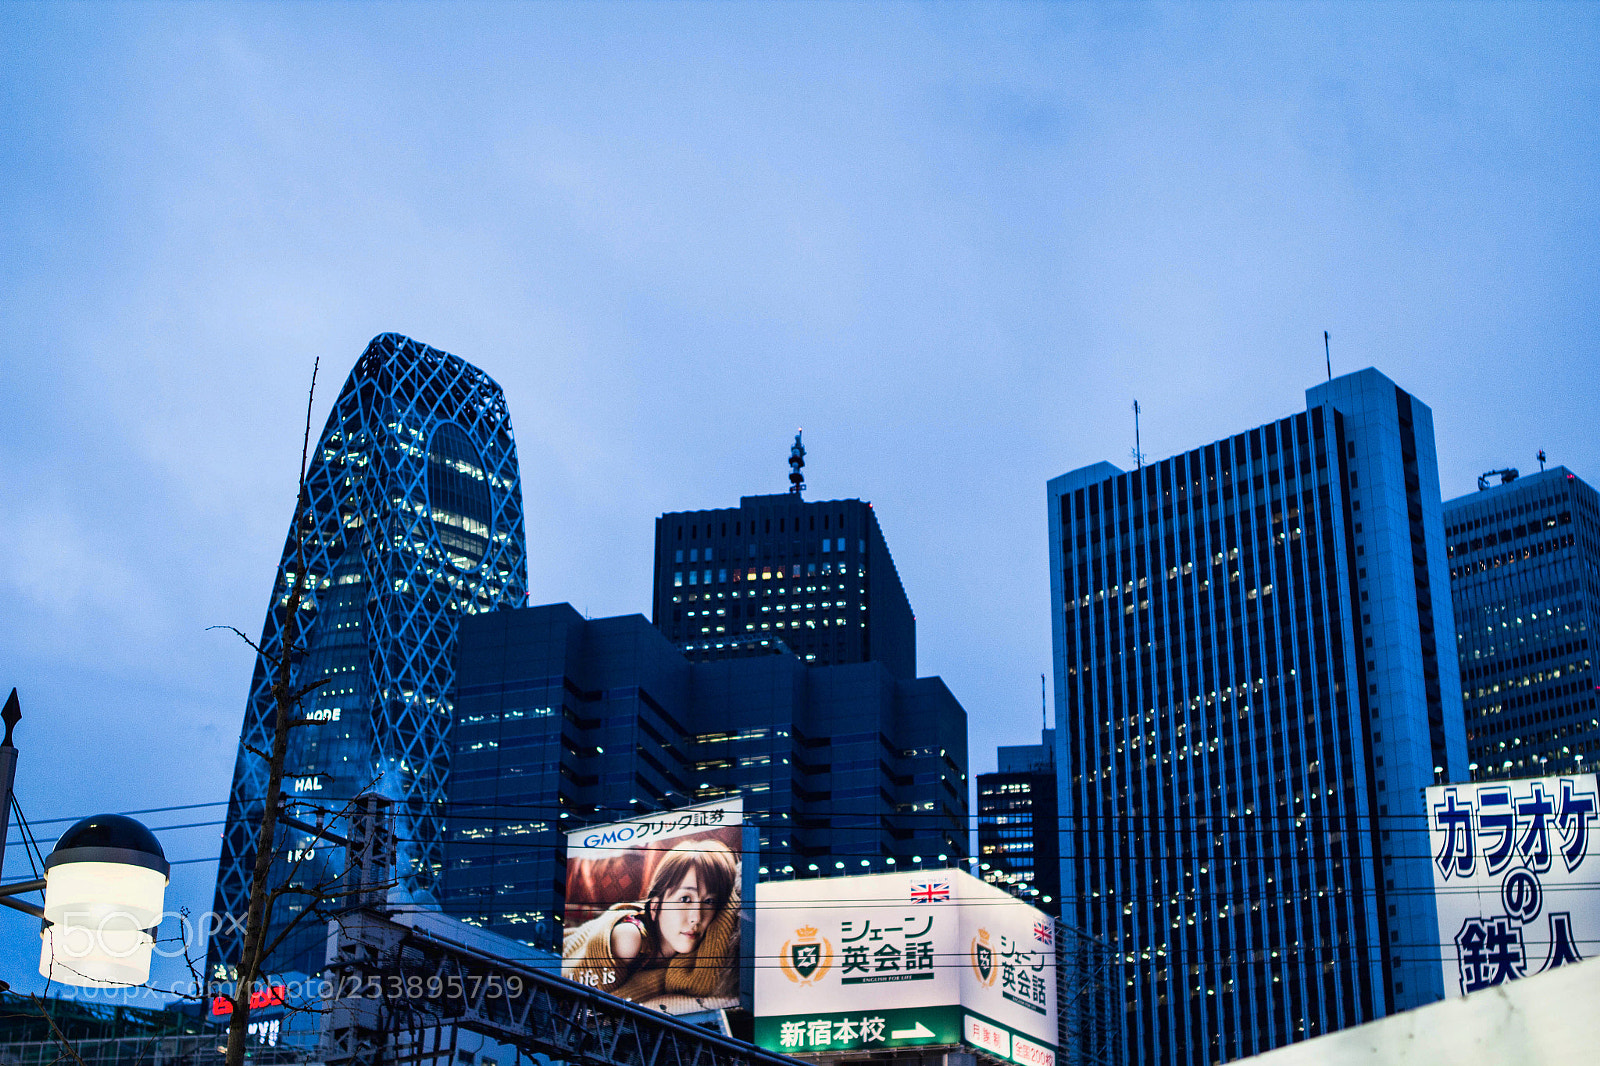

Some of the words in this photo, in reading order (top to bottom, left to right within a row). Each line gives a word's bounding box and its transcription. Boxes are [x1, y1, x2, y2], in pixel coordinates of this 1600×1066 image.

[295, 777, 322, 792] HAL
[1434, 779, 1598, 881] カラオケ
[287, 848, 315, 863] IKO
[1501, 866, 1543, 924] の
[841, 915, 934, 943] シェーン
[841, 940, 934, 974] 英会話
[1001, 935, 1044, 972] シェーン
[1454, 911, 1583, 996] 鉄人
[602, 967, 616, 984] is
[1002, 961, 1046, 1006] 英会話
[780, 1016, 886, 1048] 新宿本校
